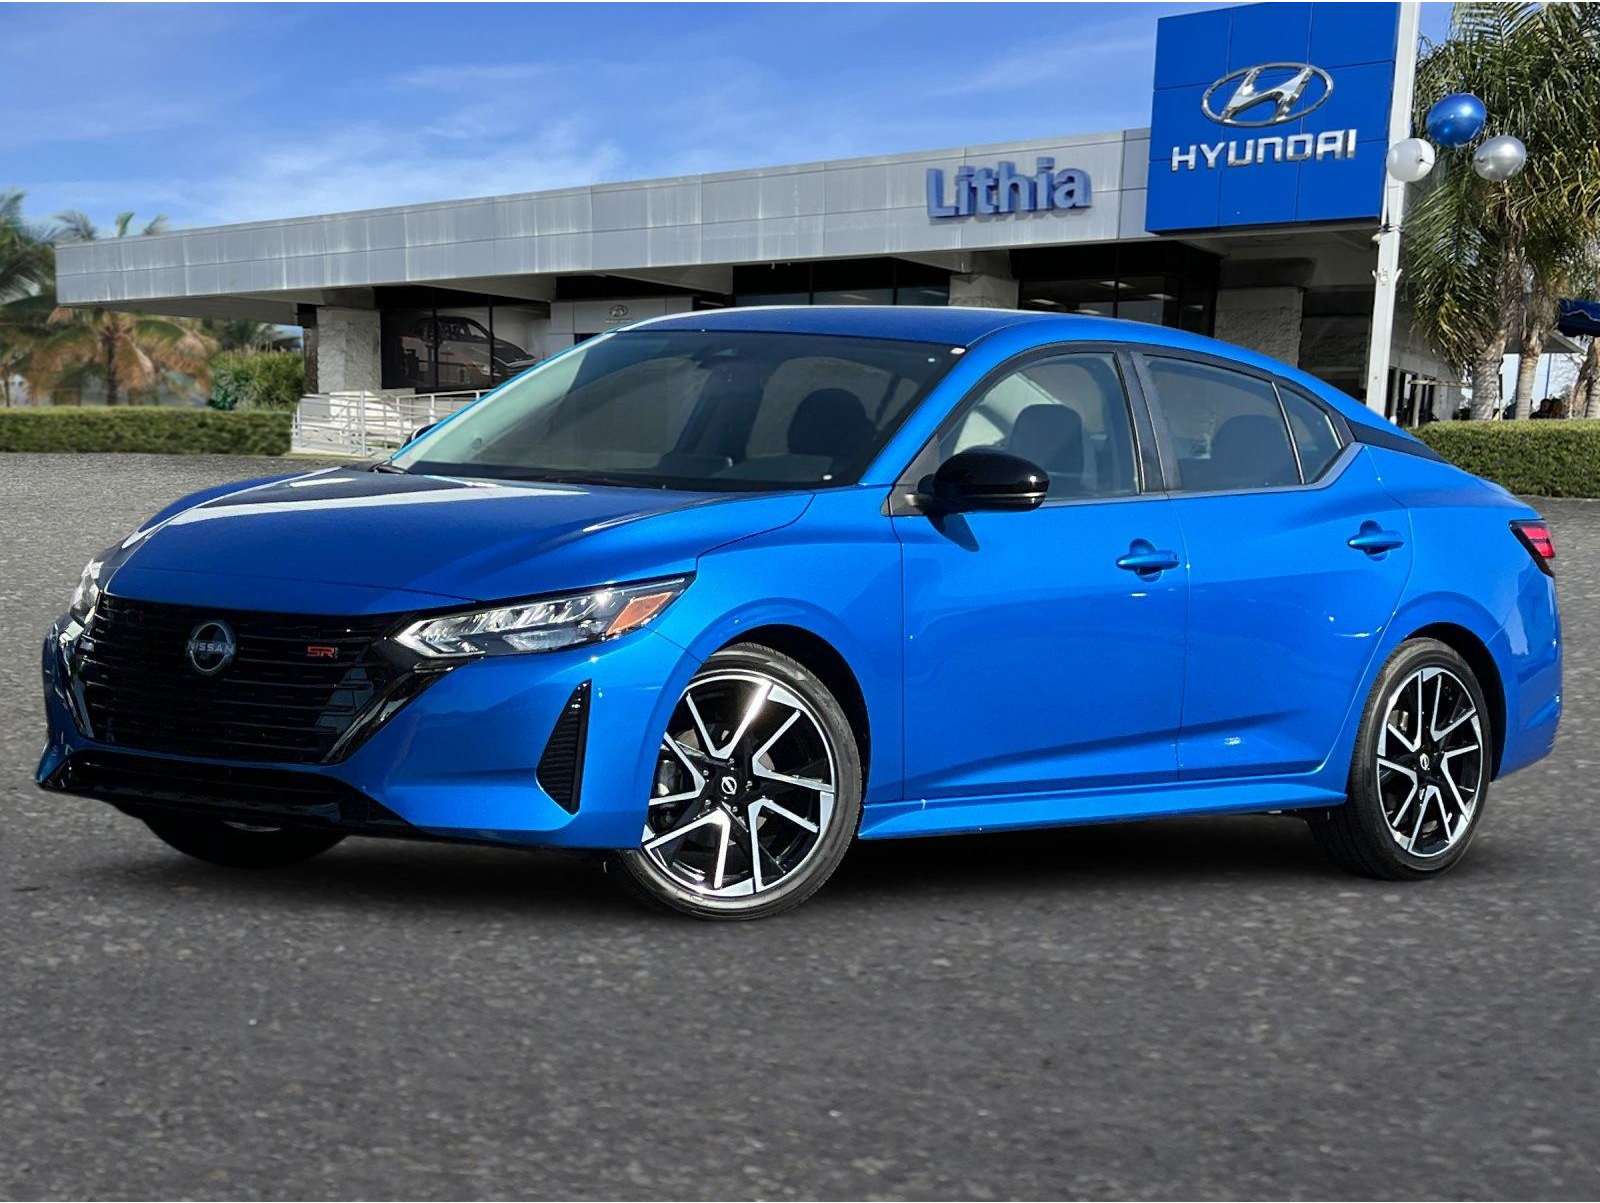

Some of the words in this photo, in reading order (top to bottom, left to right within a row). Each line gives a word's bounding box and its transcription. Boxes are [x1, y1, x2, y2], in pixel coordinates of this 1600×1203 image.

[1171, 129, 1358, 171] HYUNDAI
[927, 157, 1092, 218] Lithia
[187, 640, 234, 656] NISSAN
